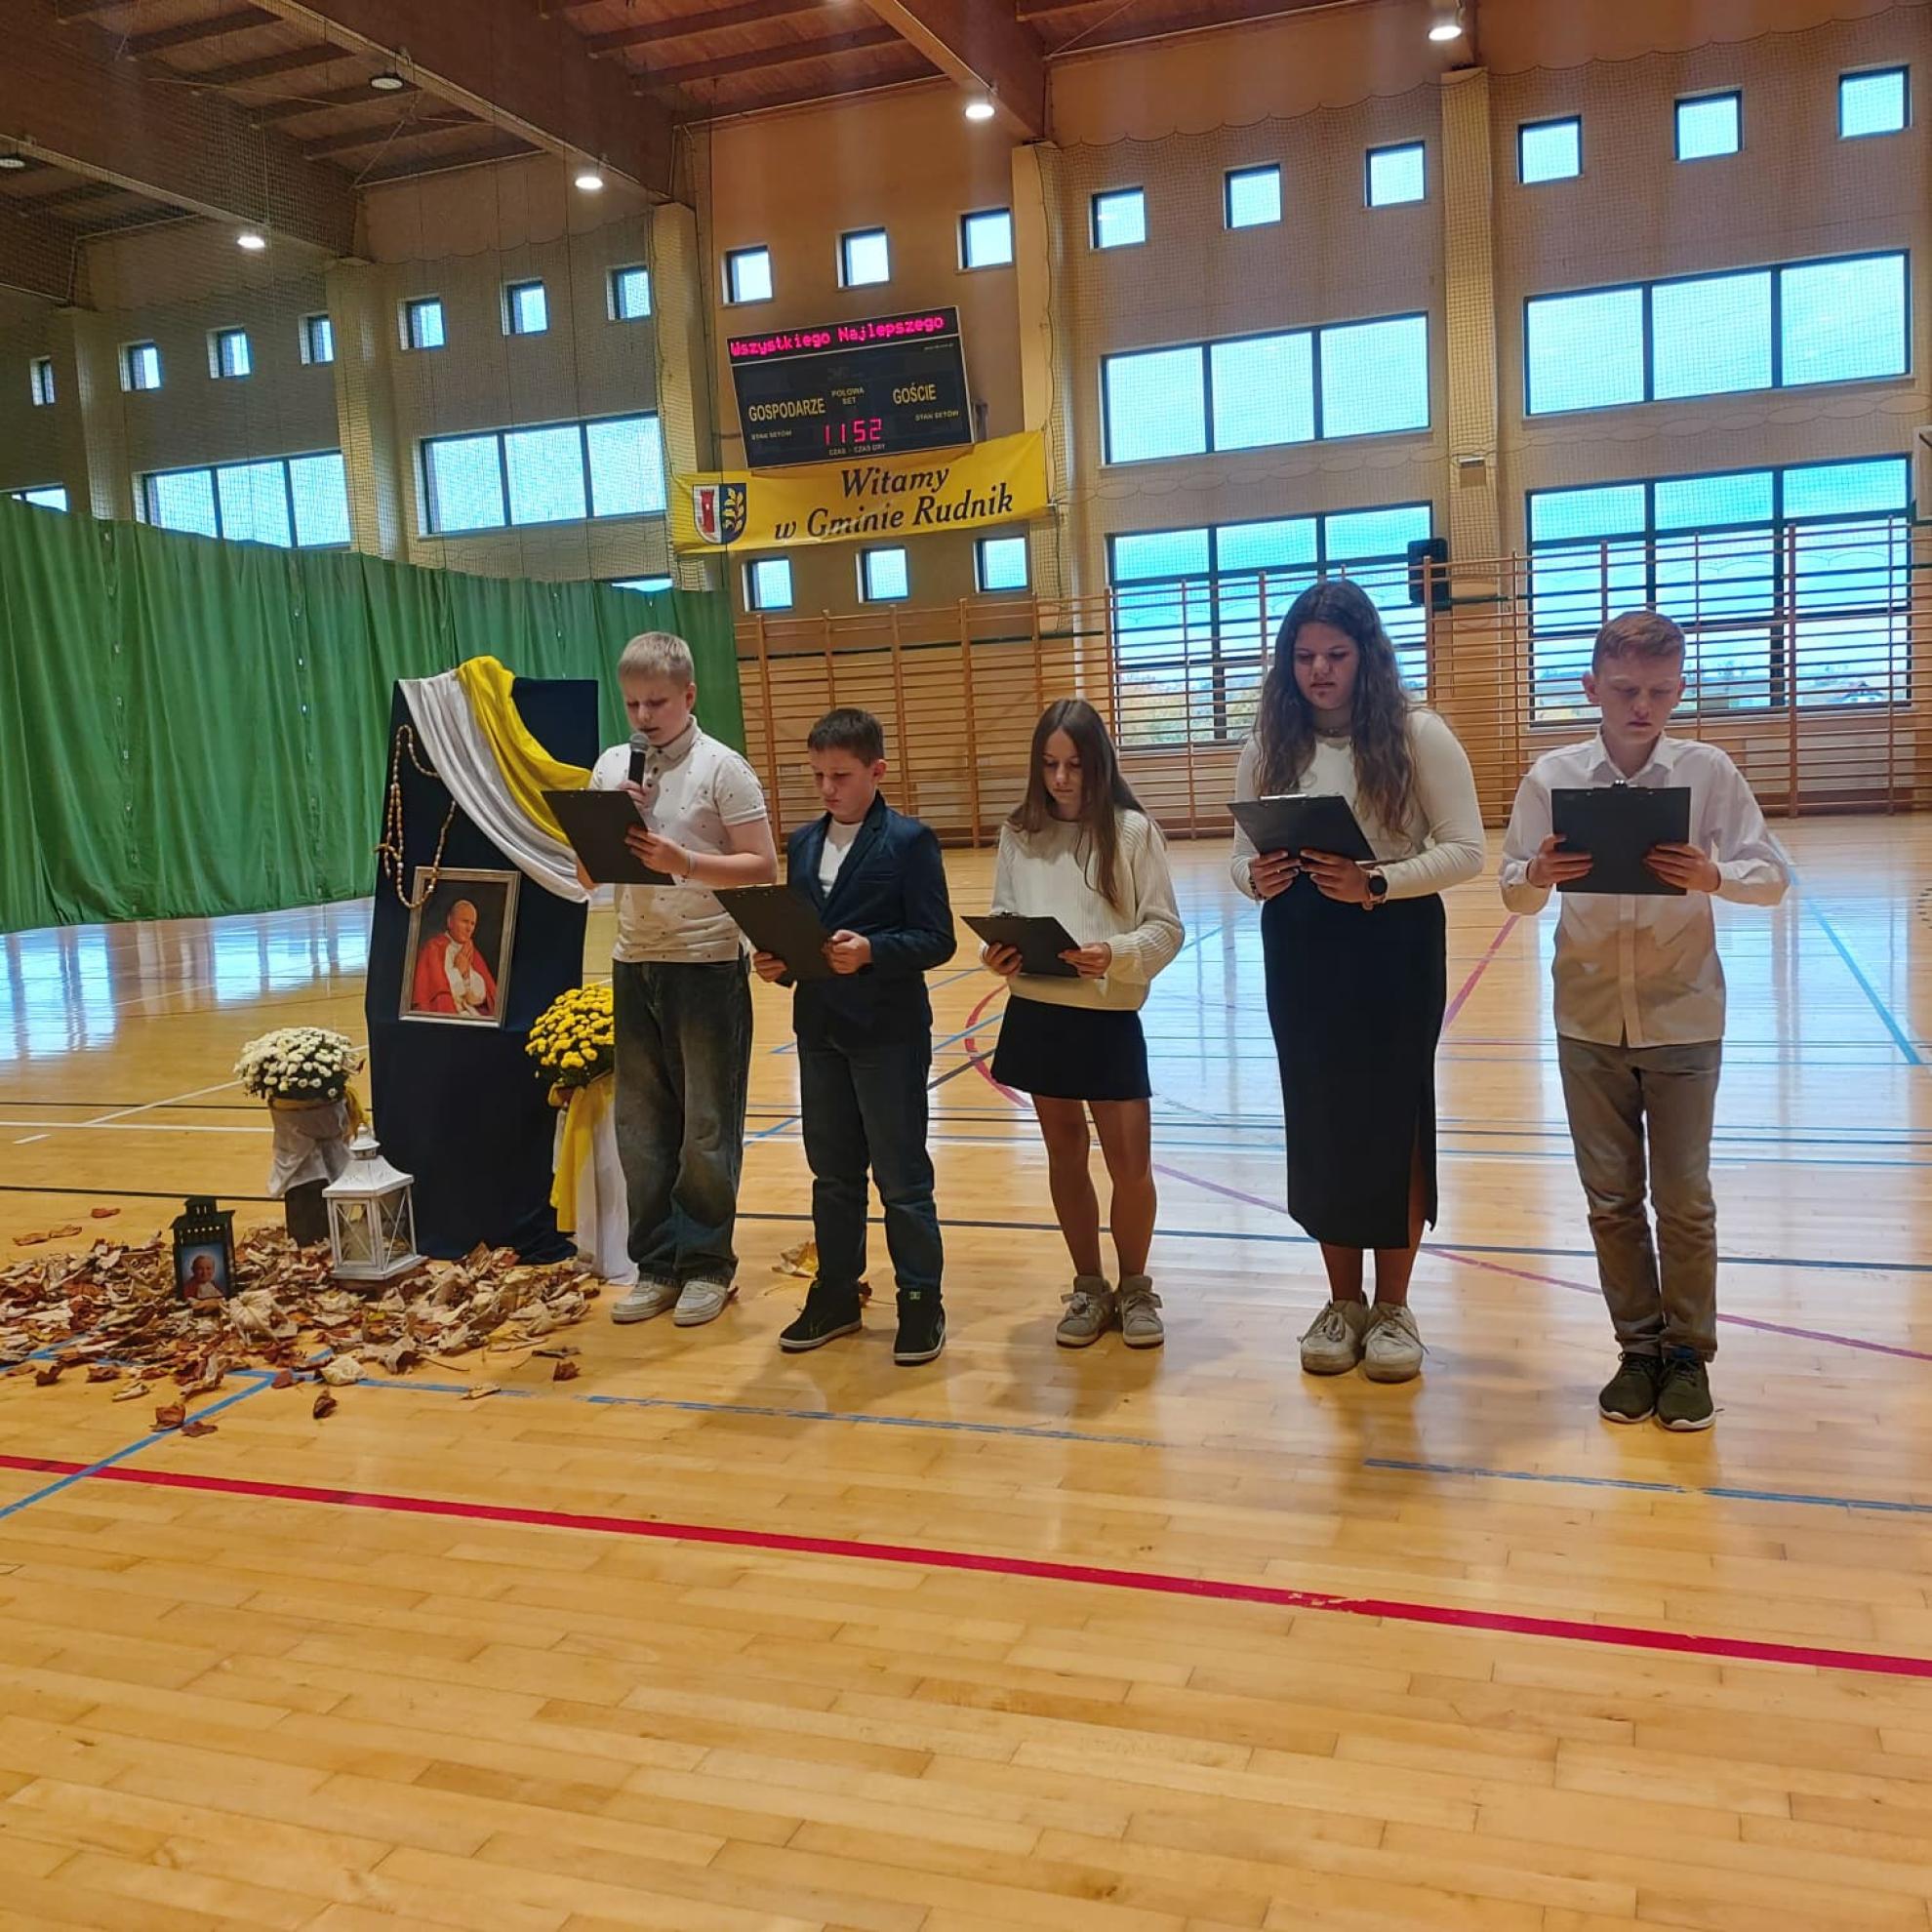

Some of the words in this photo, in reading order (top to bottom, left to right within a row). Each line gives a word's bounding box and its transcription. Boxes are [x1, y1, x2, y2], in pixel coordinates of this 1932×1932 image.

[730, 333, 831, 357] Wszystkiego
[837, 316, 945, 342] Najlepszego
[748, 398, 826, 422] GOSPODARZE
[892, 382, 937, 405] GOŚCIE
[840, 466, 950, 500] Witamy
[775, 519, 797, 541] w
[806, 503, 906, 538] Gminie
[911, 482, 1014, 527] Rudnik
